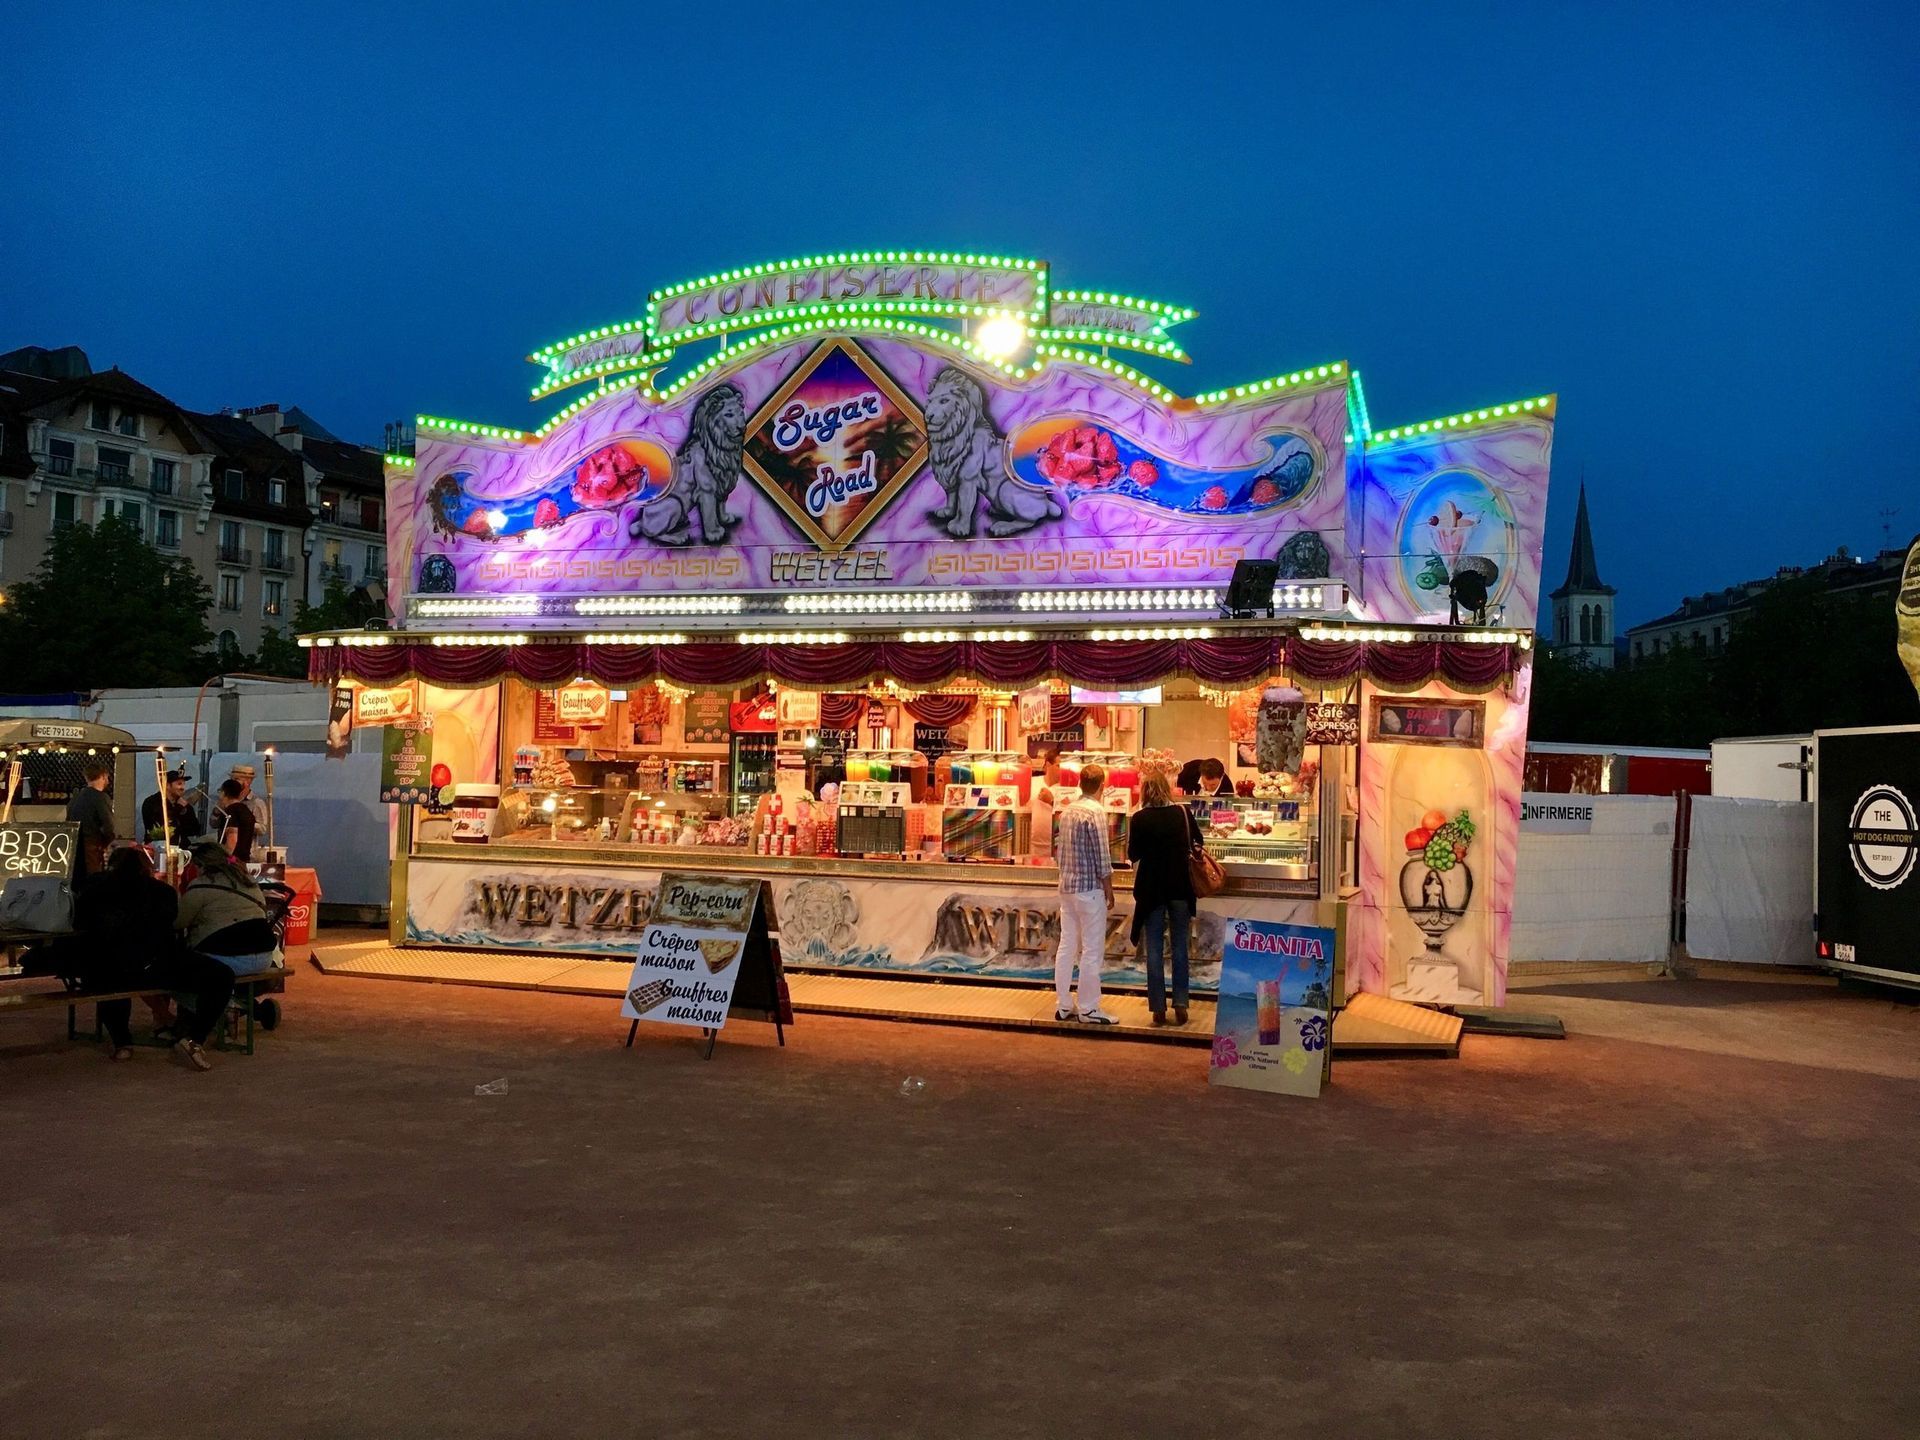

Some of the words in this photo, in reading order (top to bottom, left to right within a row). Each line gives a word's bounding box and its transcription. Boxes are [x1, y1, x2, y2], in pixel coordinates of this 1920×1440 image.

[684, 266, 1001, 325] CONFISERIE
[775, 395, 880, 448] Sugar
[808, 453, 875, 514] Road
[770, 550, 893, 581] WETZEL
[1319, 705, 1343, 718] Café
[1307, 721, 1357, 732] NESPRESSO
[1528, 806, 1592, 820] INFIRMERIE
[1874, 811, 1891, 821] THE
[0, 830, 69, 866] BBQ
[1853, 832, 1866, 841] HOT
[1868, 833, 1882, 842] DOG
[1883, 834, 1913, 843] FAKTORY
[476, 881, 652, 928] WETZE
[669, 886, 743, 911] Pop-corn
[648, 929, 699, 954] Crêpes
[1233, 932, 1324, 960] GRANITA
[640, 952, 696, 971] maison
[659, 978, 729, 1003] Gauffres
[666, 1003, 723, 1023] maison
